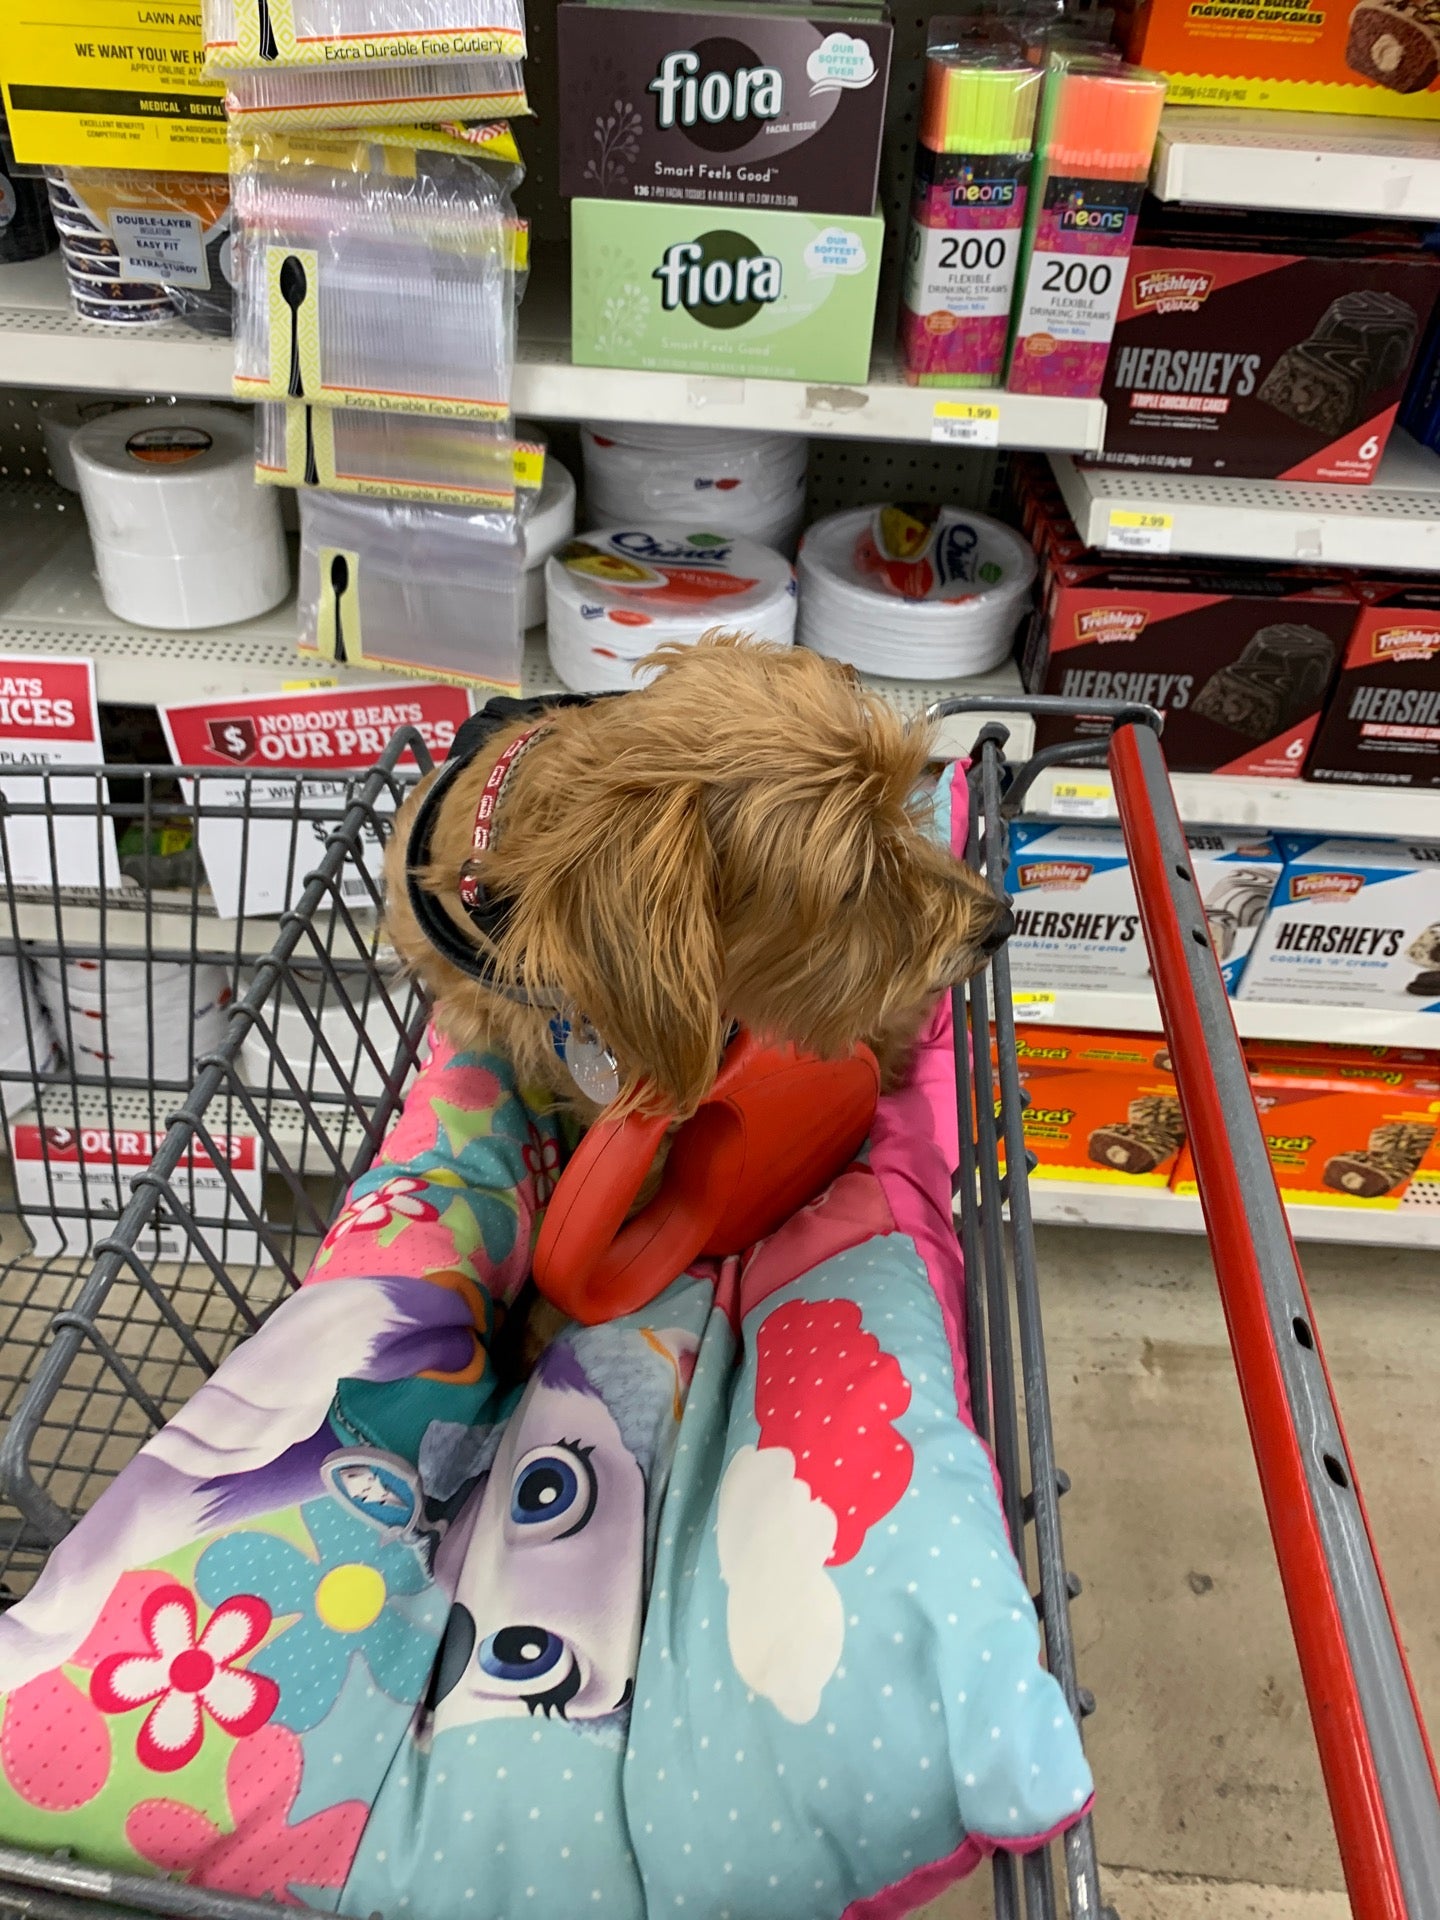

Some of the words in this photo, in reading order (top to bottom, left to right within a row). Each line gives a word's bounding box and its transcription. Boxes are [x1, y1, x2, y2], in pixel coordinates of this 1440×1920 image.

[138, 11, 174, 25] LAWN
[75, 43, 95, 57] WE
[98, 45, 134, 60] WANT
[137, 47, 167, 62] YOU!
[170, 49, 190, 63] WE
[194, 51, 206, 64] HI
[324, 45, 360, 60] Extra
[364, 42, 418, 59] Durable
[421, 39, 450, 55] Fine
[453, 37, 503, 54] Cutlery
[831, 44, 854, 54] OUR
[131, 63, 155, 74] APPLY
[818, 54, 865, 66] SOFTEST
[827, 66, 855, 76] EVER
[650, 50, 784, 127] fiora
[139, 99, 181, 113] MEDICAL
[190, 103, 223, 116] DENTAL
[654, 161, 694, 177] Smart
[698, 165, 732, 180] Feels
[955, 185, 1013, 200] neons
[116, 215, 192, 229] DOUBLE-LAYER
[1064, 210, 1124, 228] neons
[136, 240, 160, 250] EASY
[164, 241, 178, 251] FIT
[826, 235, 848, 245] OUR
[814, 245, 858, 256] SOFTEST
[938, 237, 1006, 269] 200
[129, 258, 198, 275] EXTRA-STURDY
[822, 256, 848, 265] EVER
[653, 242, 782, 309] fiora
[948, 274, 991, 284] FLEXIBLE
[1042, 261, 1112, 295] 200
[928, 284, 972, 295] DRINKING
[1139, 275, 1209, 298] Freshley's
[1051, 296, 1094, 309] FLEXIBLE
[1029, 306, 1073, 319] DRINKING
[1114, 346, 1262, 397] HERSHEY'S
[967, 407, 992, 419] 1.99
[1358, 435, 1379, 460] 6
[1140, 514, 1165, 527] 2.99
[0, 677, 43, 697] ATS
[1062, 668, 1194, 709] HERSHEY'S
[0, 697, 76, 728] ICES
[1348, 686, 1440, 725] HERSHE
[258, 708, 349, 735] NOBODY
[352, 703, 423, 727] BEATS
[259, 729, 334, 761] OUR
[335, 720, 456, 756] PRIES
[1285, 738, 1304, 759] 6
[1011, 909, 1140, 942] HERSHEY'S
[1084, 944, 1128, 953] creme
[1275, 922, 1405, 957] HERSHEY'S
[82, 1130, 139, 1155] OUR
